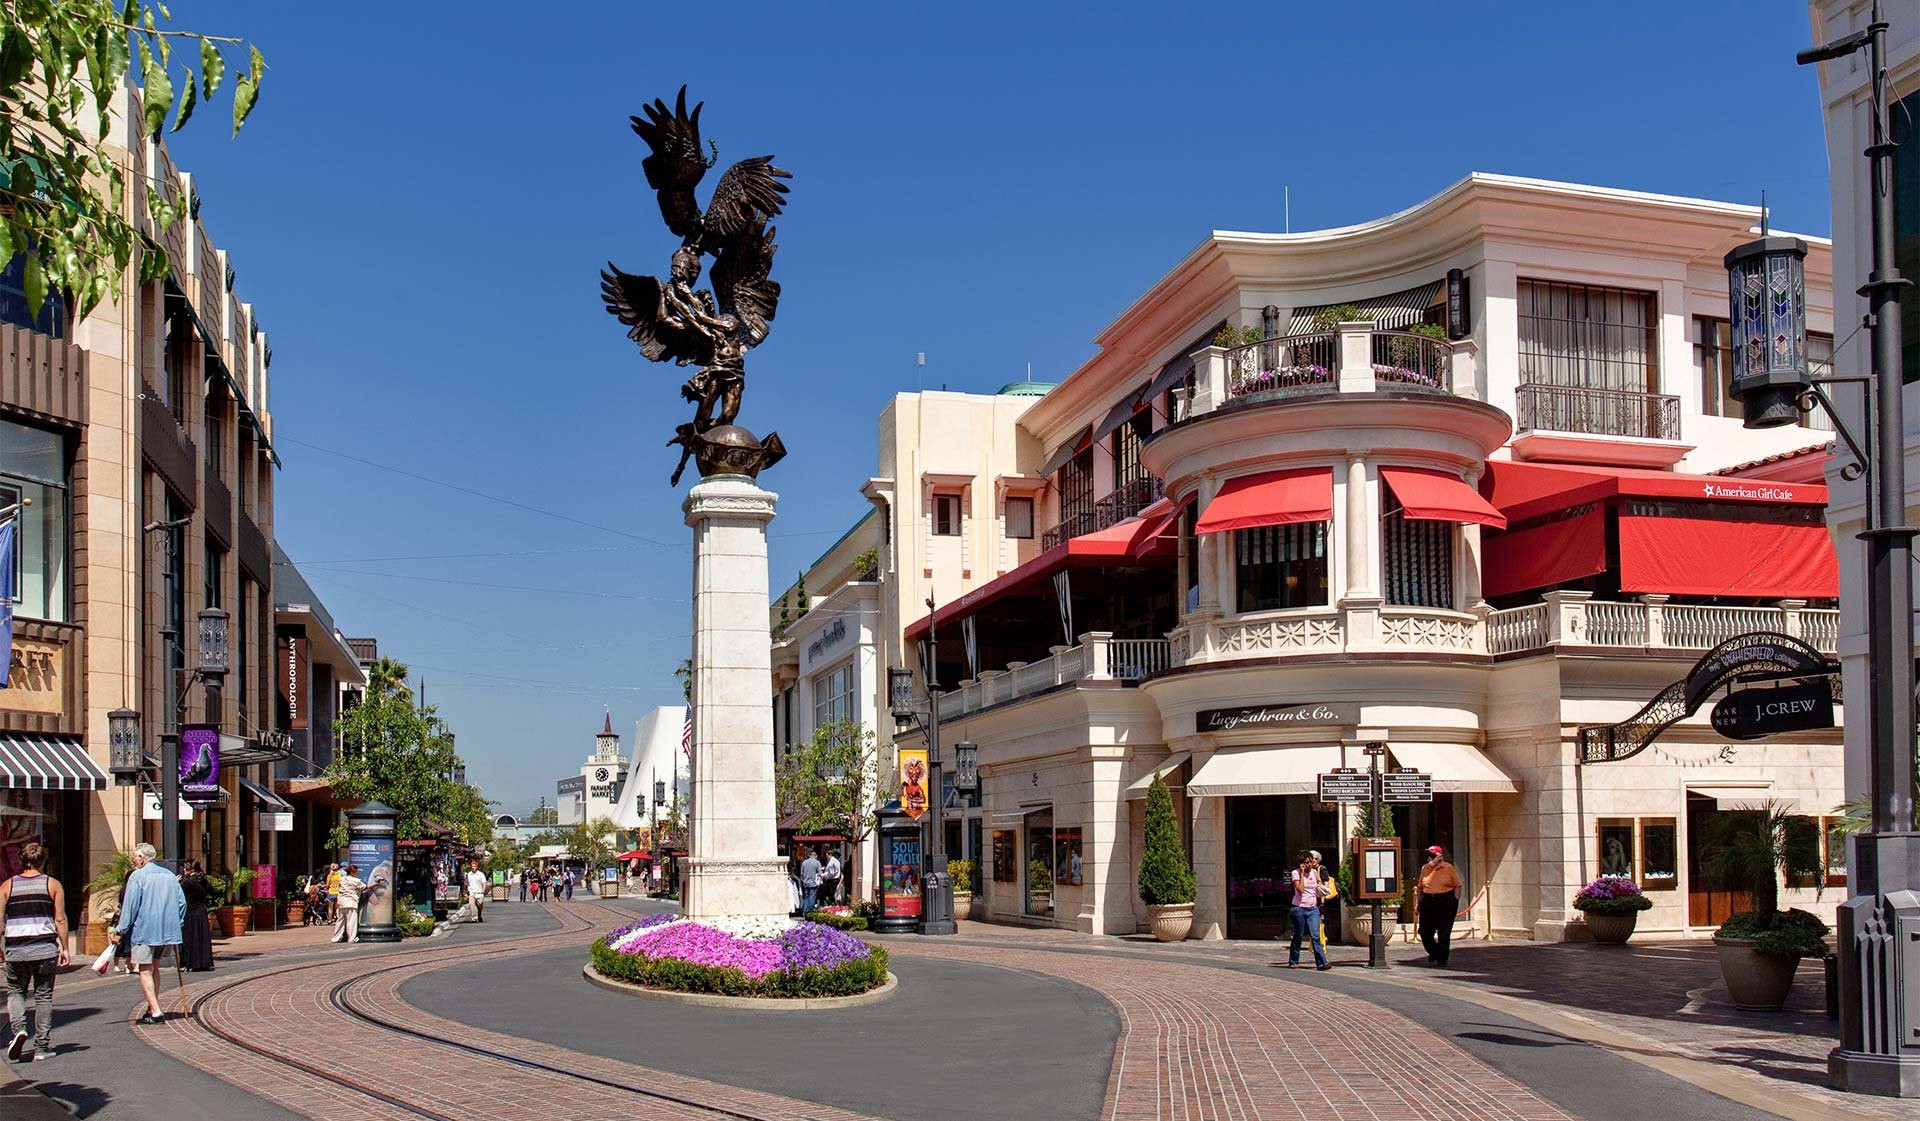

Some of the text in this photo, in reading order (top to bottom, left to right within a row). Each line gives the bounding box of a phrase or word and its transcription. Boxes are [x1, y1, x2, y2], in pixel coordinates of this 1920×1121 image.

[1716, 485, 1793, 500] American Girl Cafe
[11, 649, 53, 670] RET
[1721, 648, 1775, 667] WHISPER
[289, 636, 297, 719] ANTHROPOLOGIE
[1208, 706, 1339, 729] Lucy Zahran & Co.
[1716, 706, 1738, 717] BAR
[1755, 700, 1816, 721] J.CREW
[1715, 717, 1738, 727] NEW
